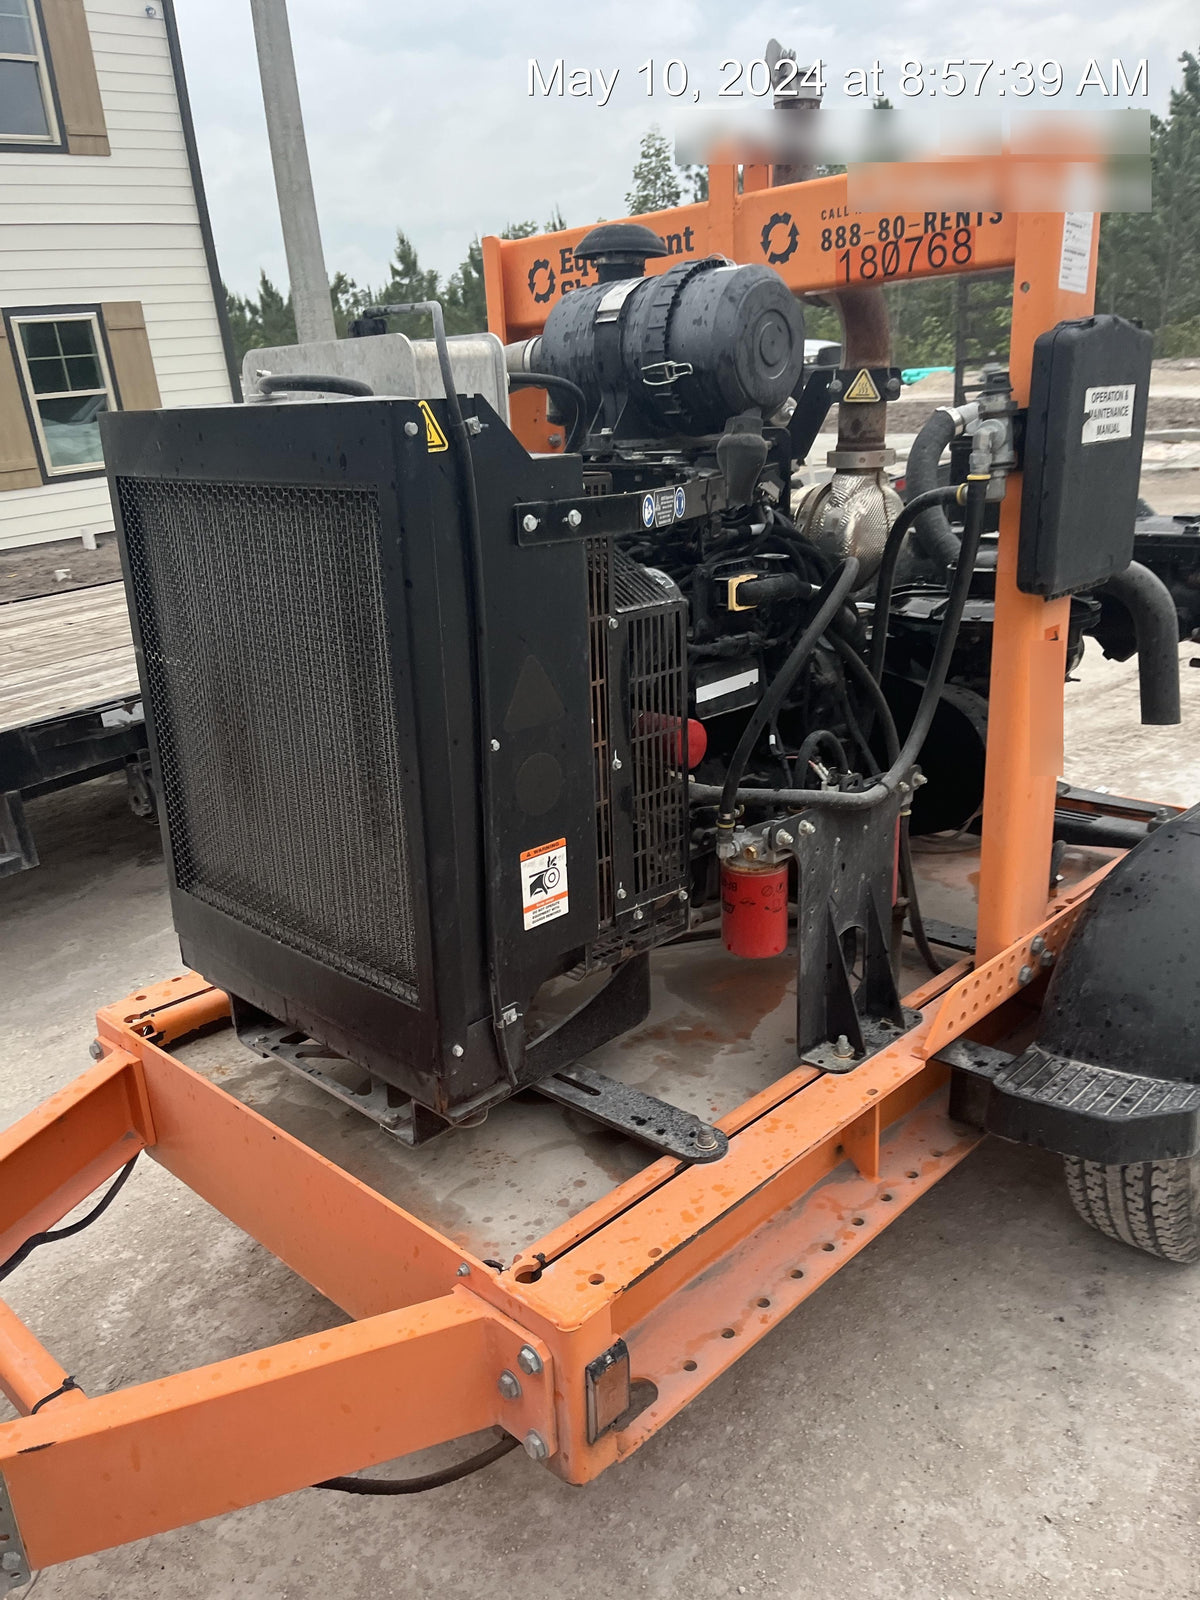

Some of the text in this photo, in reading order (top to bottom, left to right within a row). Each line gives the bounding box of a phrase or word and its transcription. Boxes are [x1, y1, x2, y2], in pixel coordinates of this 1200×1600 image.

[820, 205, 849, 221] CALL
[839, 228, 972, 283] 180768
[1091, 390, 1124, 403] OPERATION
[1096, 423, 1120, 435] MANUAL
[533, 842, 559, 854] WARNING
